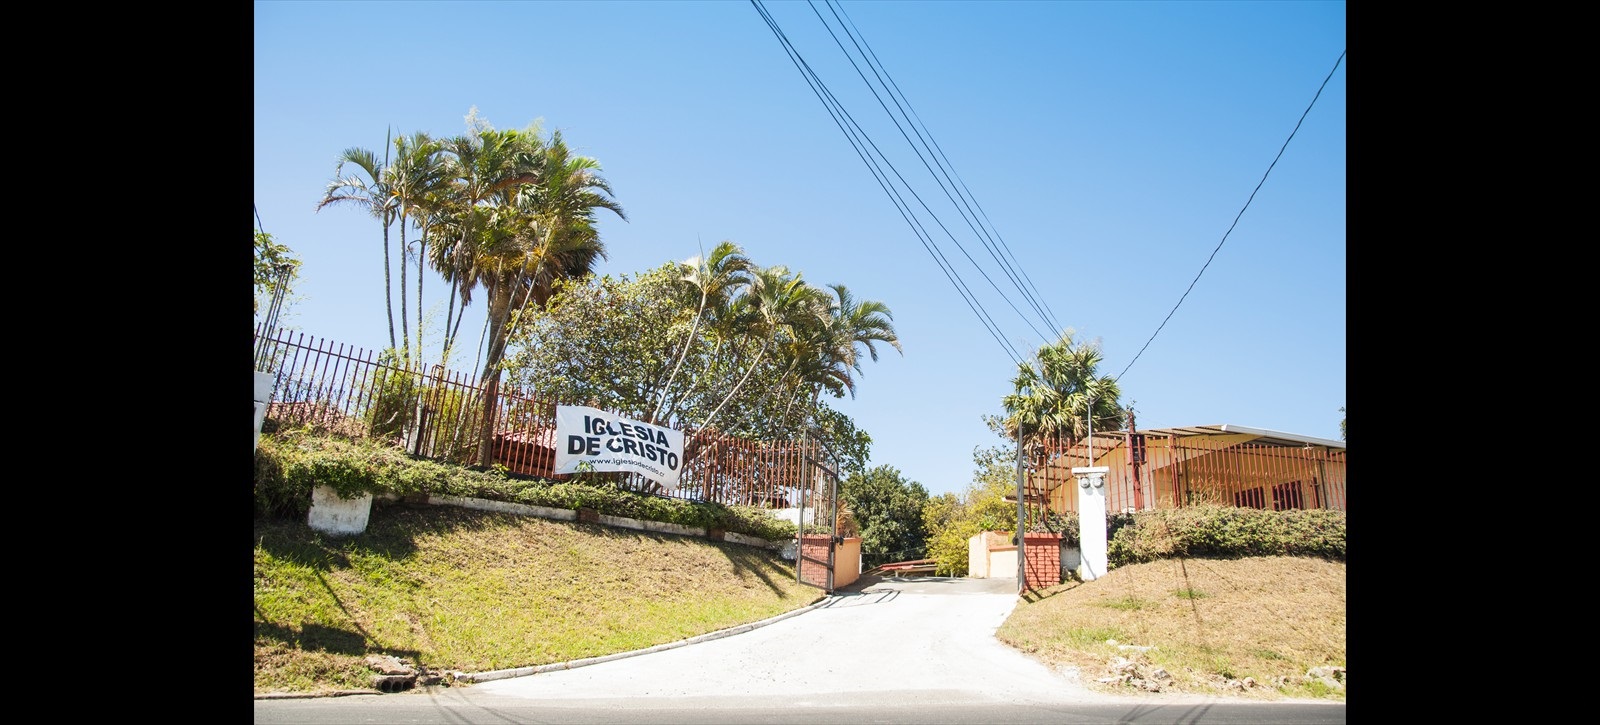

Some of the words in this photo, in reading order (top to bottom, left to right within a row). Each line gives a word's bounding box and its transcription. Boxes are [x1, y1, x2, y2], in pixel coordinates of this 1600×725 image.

[584, 415, 670, 448] IGLESIA
[567, 435, 601, 455] DE
[606, 437, 679, 471] CRISTO
[589, 458, 665, 477] www.iglesiadecristo.cr
